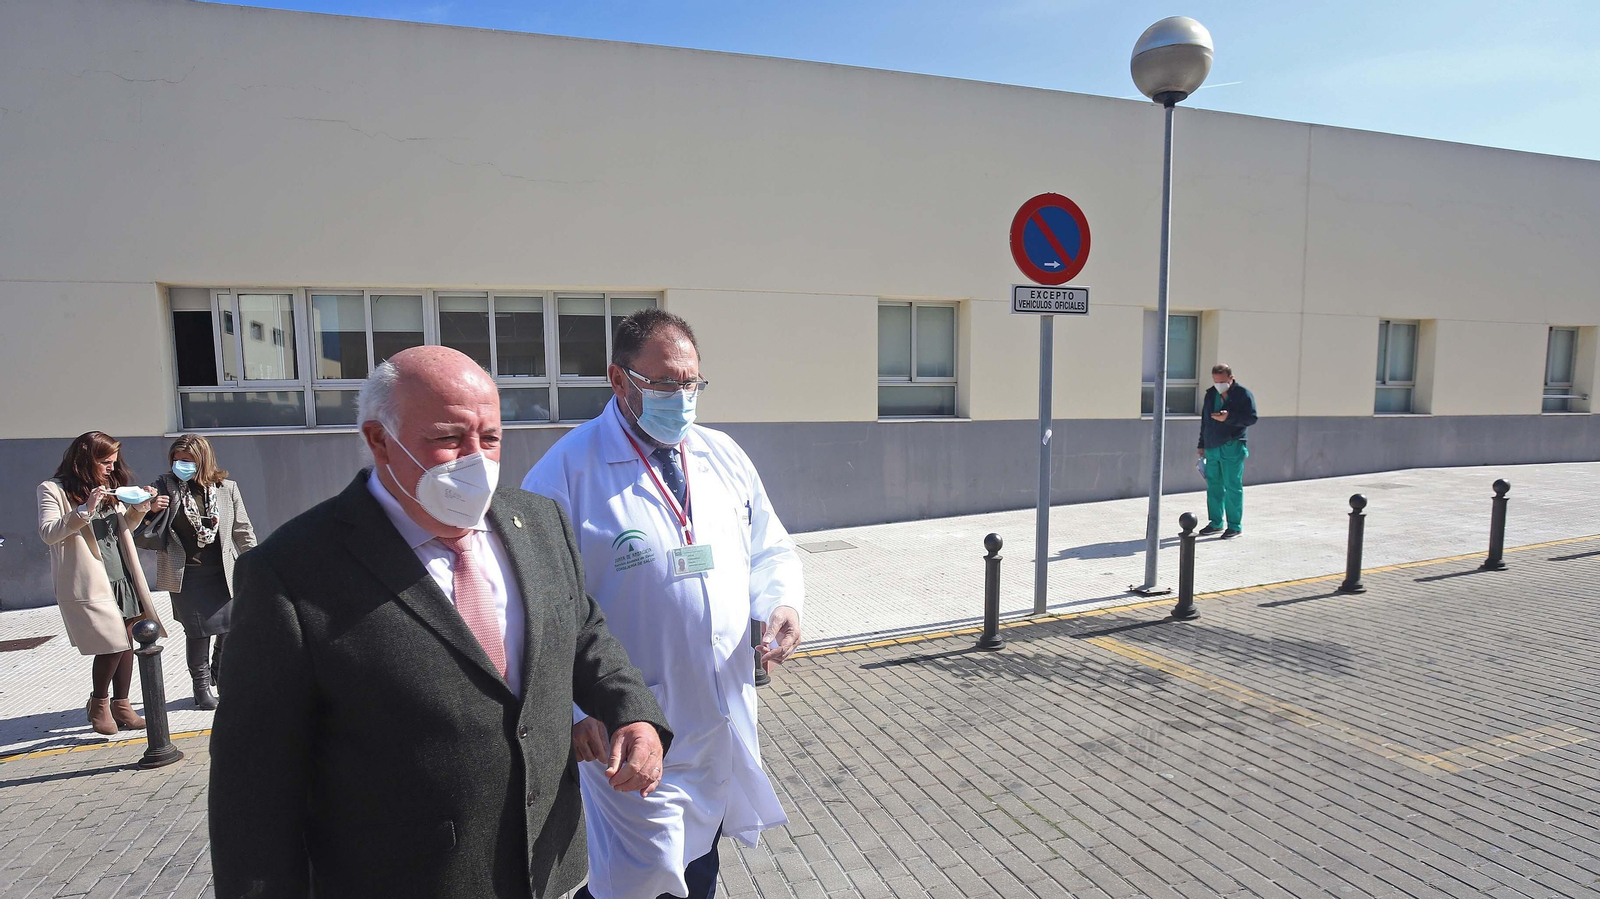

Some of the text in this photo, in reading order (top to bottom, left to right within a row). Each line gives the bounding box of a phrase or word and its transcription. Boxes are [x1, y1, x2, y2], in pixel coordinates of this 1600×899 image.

[1030, 290, 1074, 300] EXCEPTO
[1018, 299, 1085, 310] VEHICULOS OFICIALES
